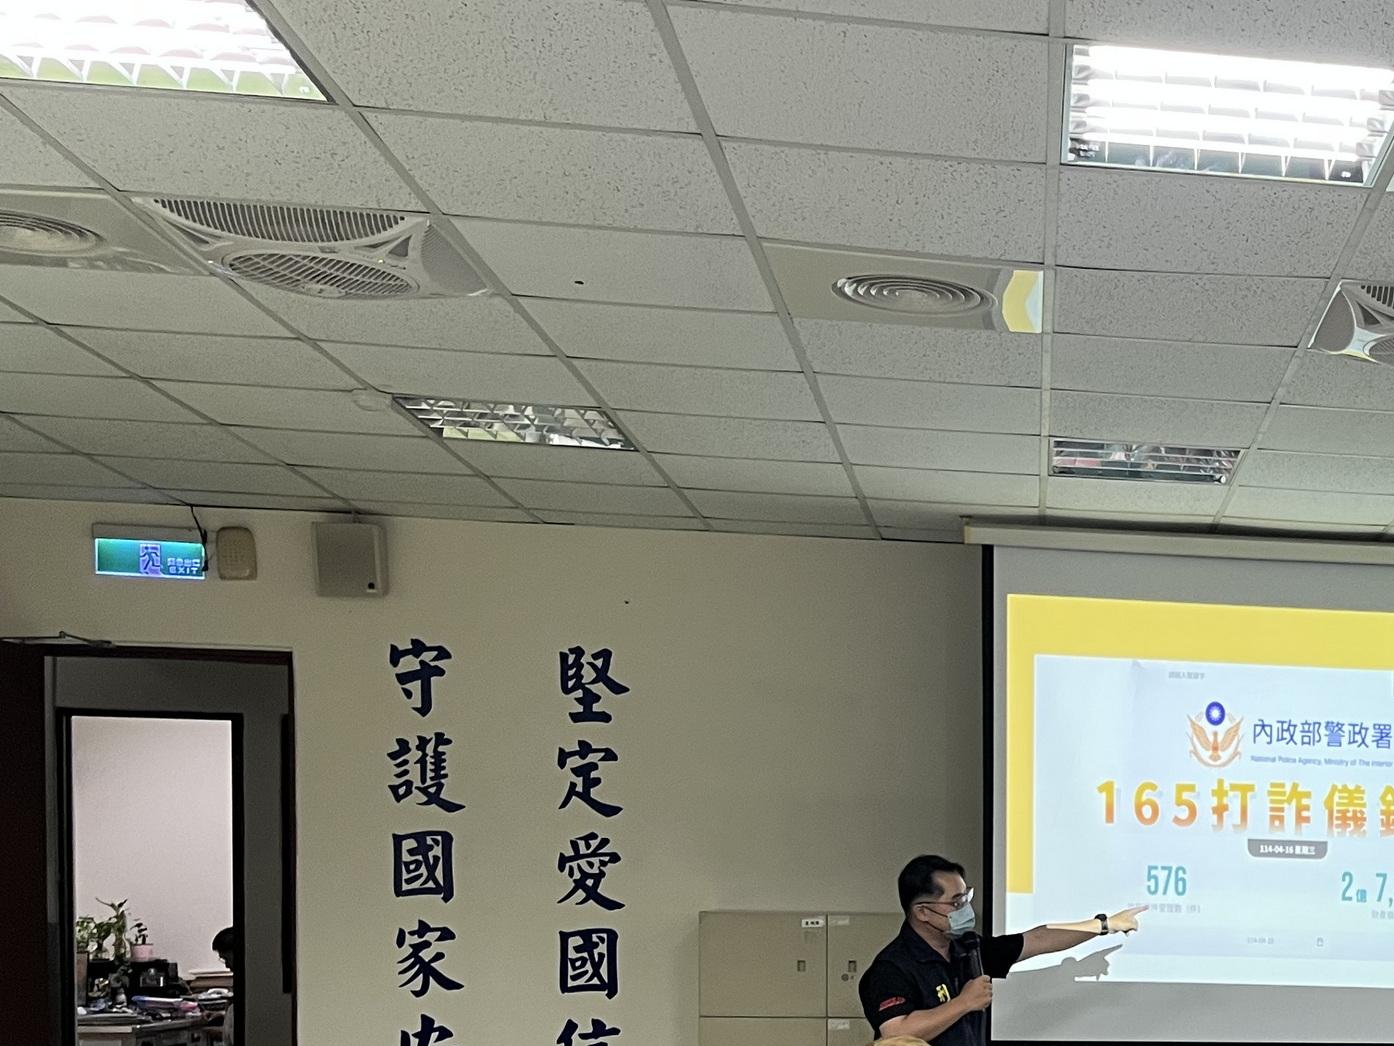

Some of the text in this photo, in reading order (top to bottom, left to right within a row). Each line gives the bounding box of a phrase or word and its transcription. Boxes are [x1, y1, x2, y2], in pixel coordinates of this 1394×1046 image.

[169, 566, 198, 575] EXIT
[1252, 718, 1393, 749] 內政部警政署
[1146, 865, 1187, 896] 576
